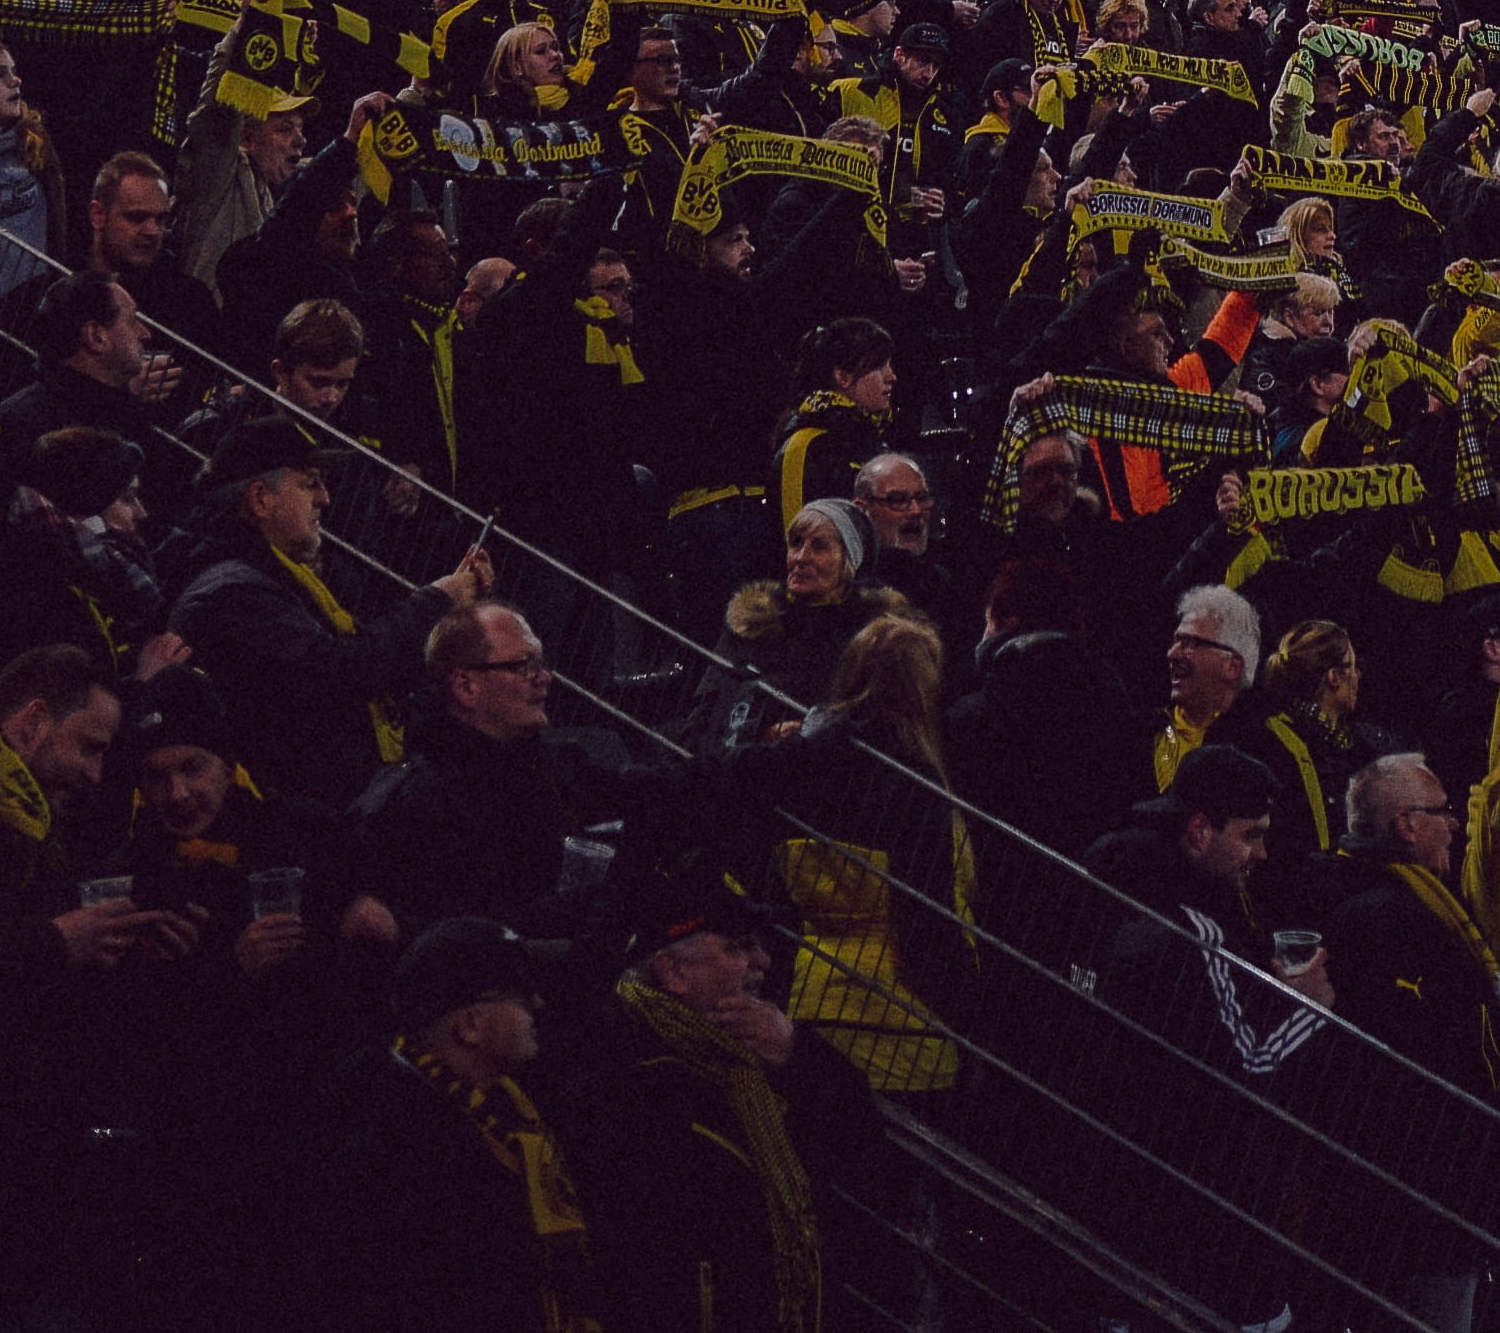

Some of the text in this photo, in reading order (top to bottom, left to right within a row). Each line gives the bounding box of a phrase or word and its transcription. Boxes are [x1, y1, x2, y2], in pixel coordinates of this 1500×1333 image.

[248, 37, 276, 61] BVB
[389, 112, 419, 155] BVB
[512, 132, 604, 166] Dortmund
[727, 136, 796, 162] Borussia
[801, 139, 877, 183] Dortmund
[1089, 192, 1212, 228] BORUSSIA DORTMUND
[1192, 252, 1224, 275] NEVER
[1225, 258, 1254, 279] WALK
[1248, 463, 1425, 526] BORUSSIA
